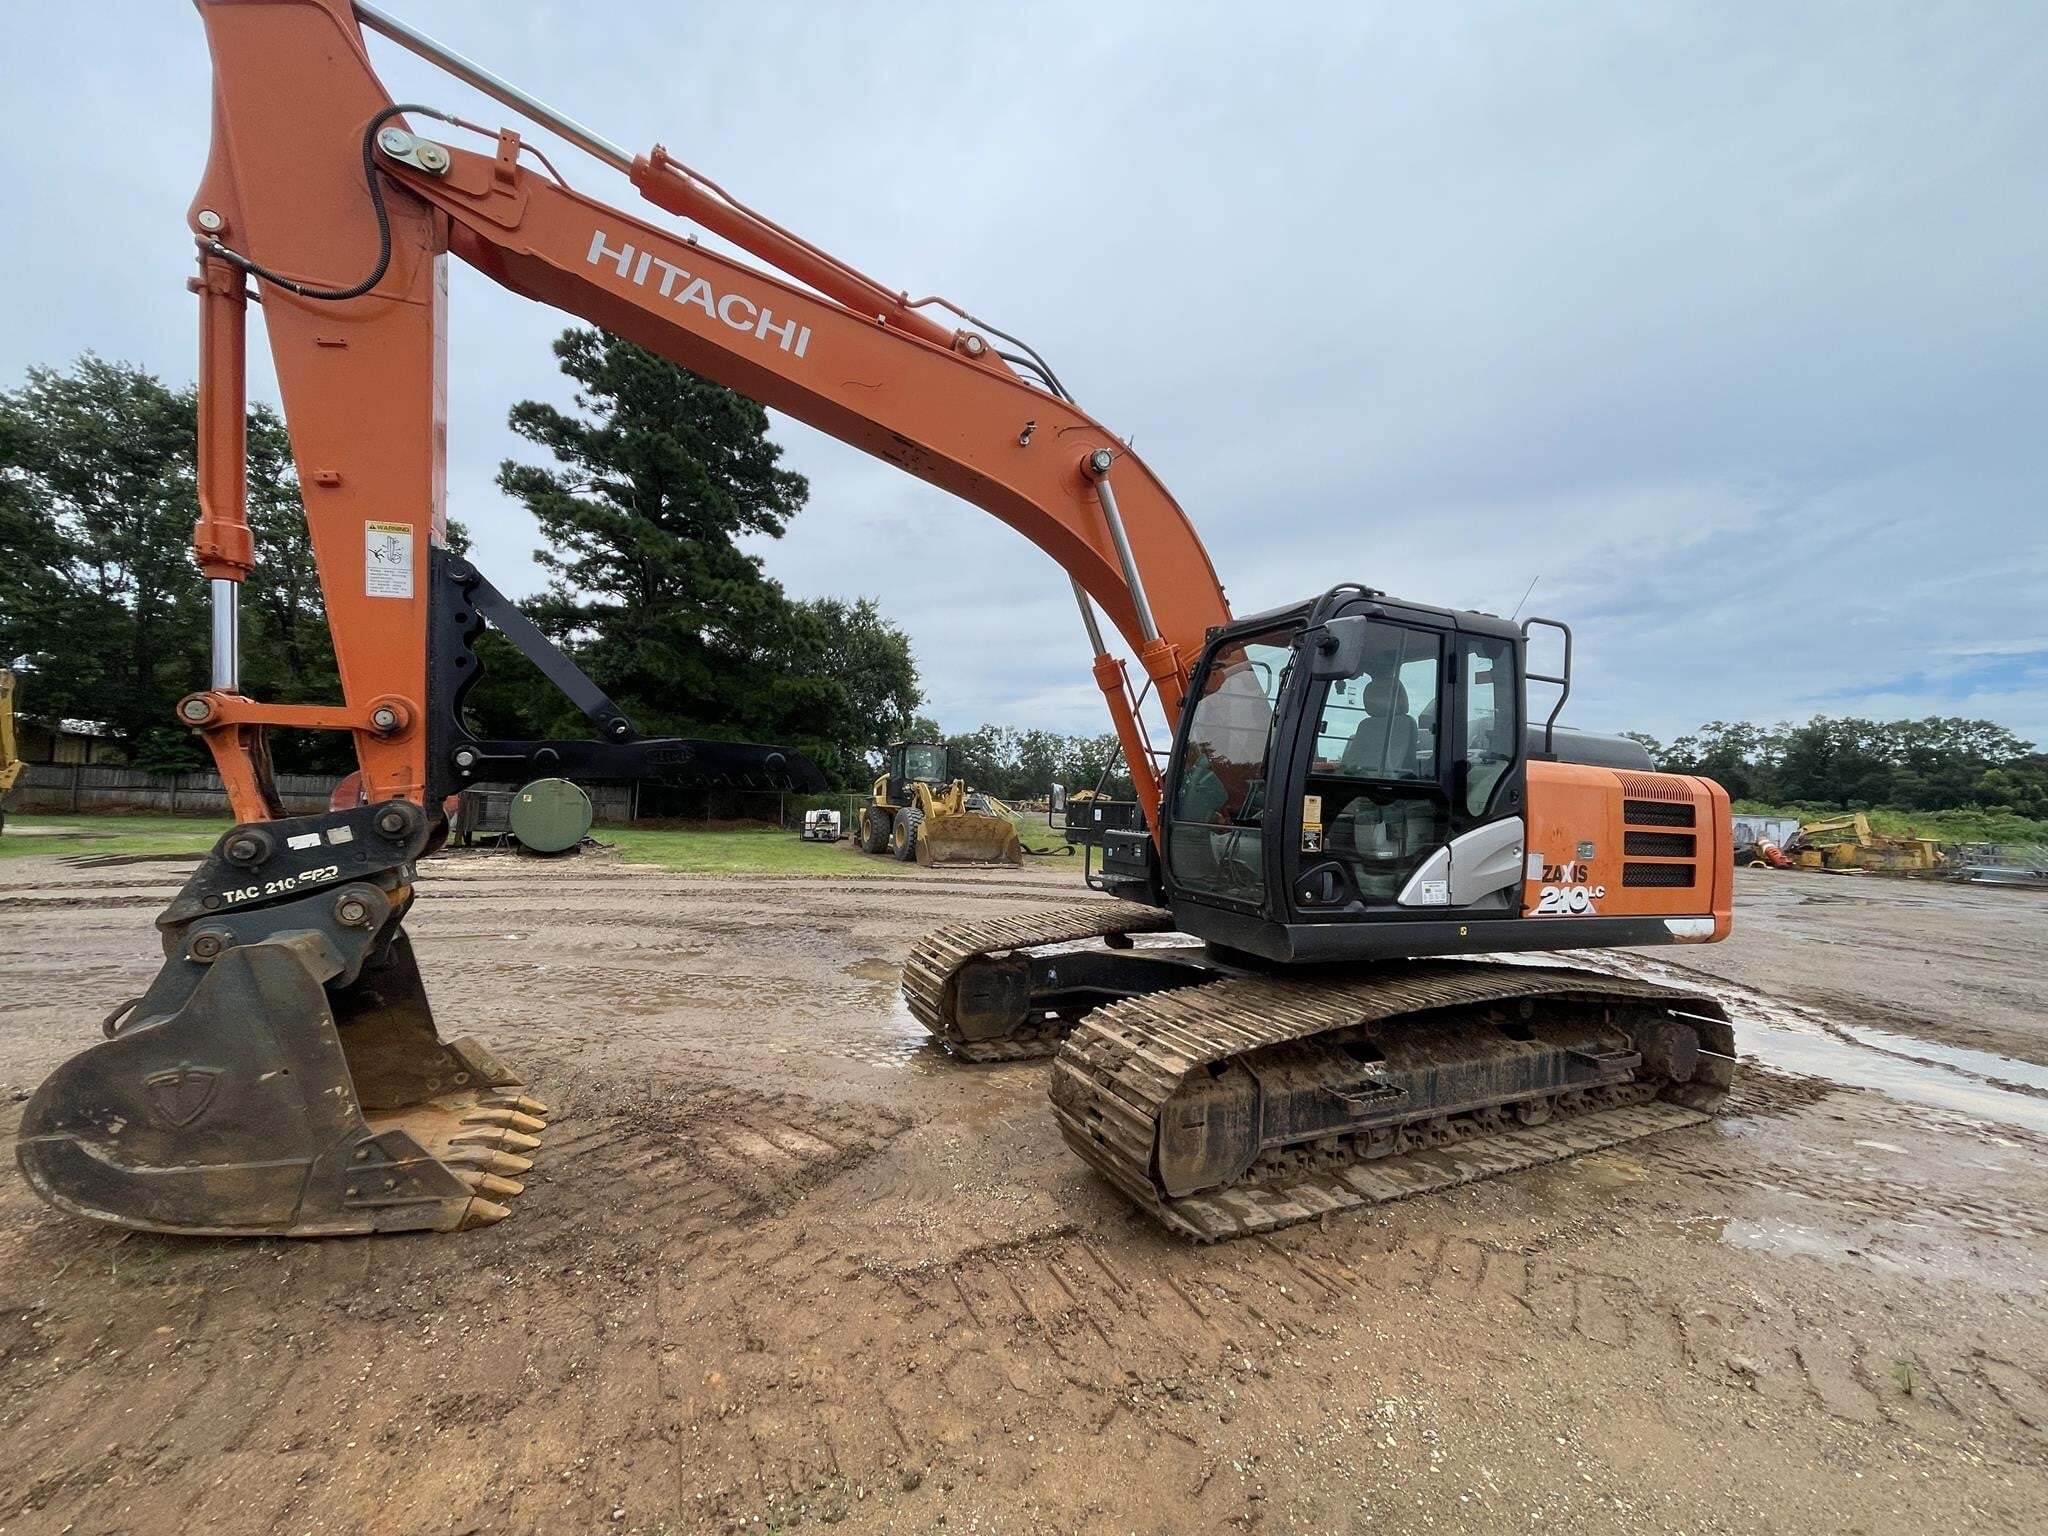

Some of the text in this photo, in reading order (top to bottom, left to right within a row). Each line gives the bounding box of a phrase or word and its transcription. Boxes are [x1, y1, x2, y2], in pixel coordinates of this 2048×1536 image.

[586, 230, 811, 358] HITACHI
[376, 524, 410, 533] WARNING
[1541, 861, 1588, 884] ZAXIS
[222, 886, 260, 904] TAC
[264, 878, 296, 895] 210
